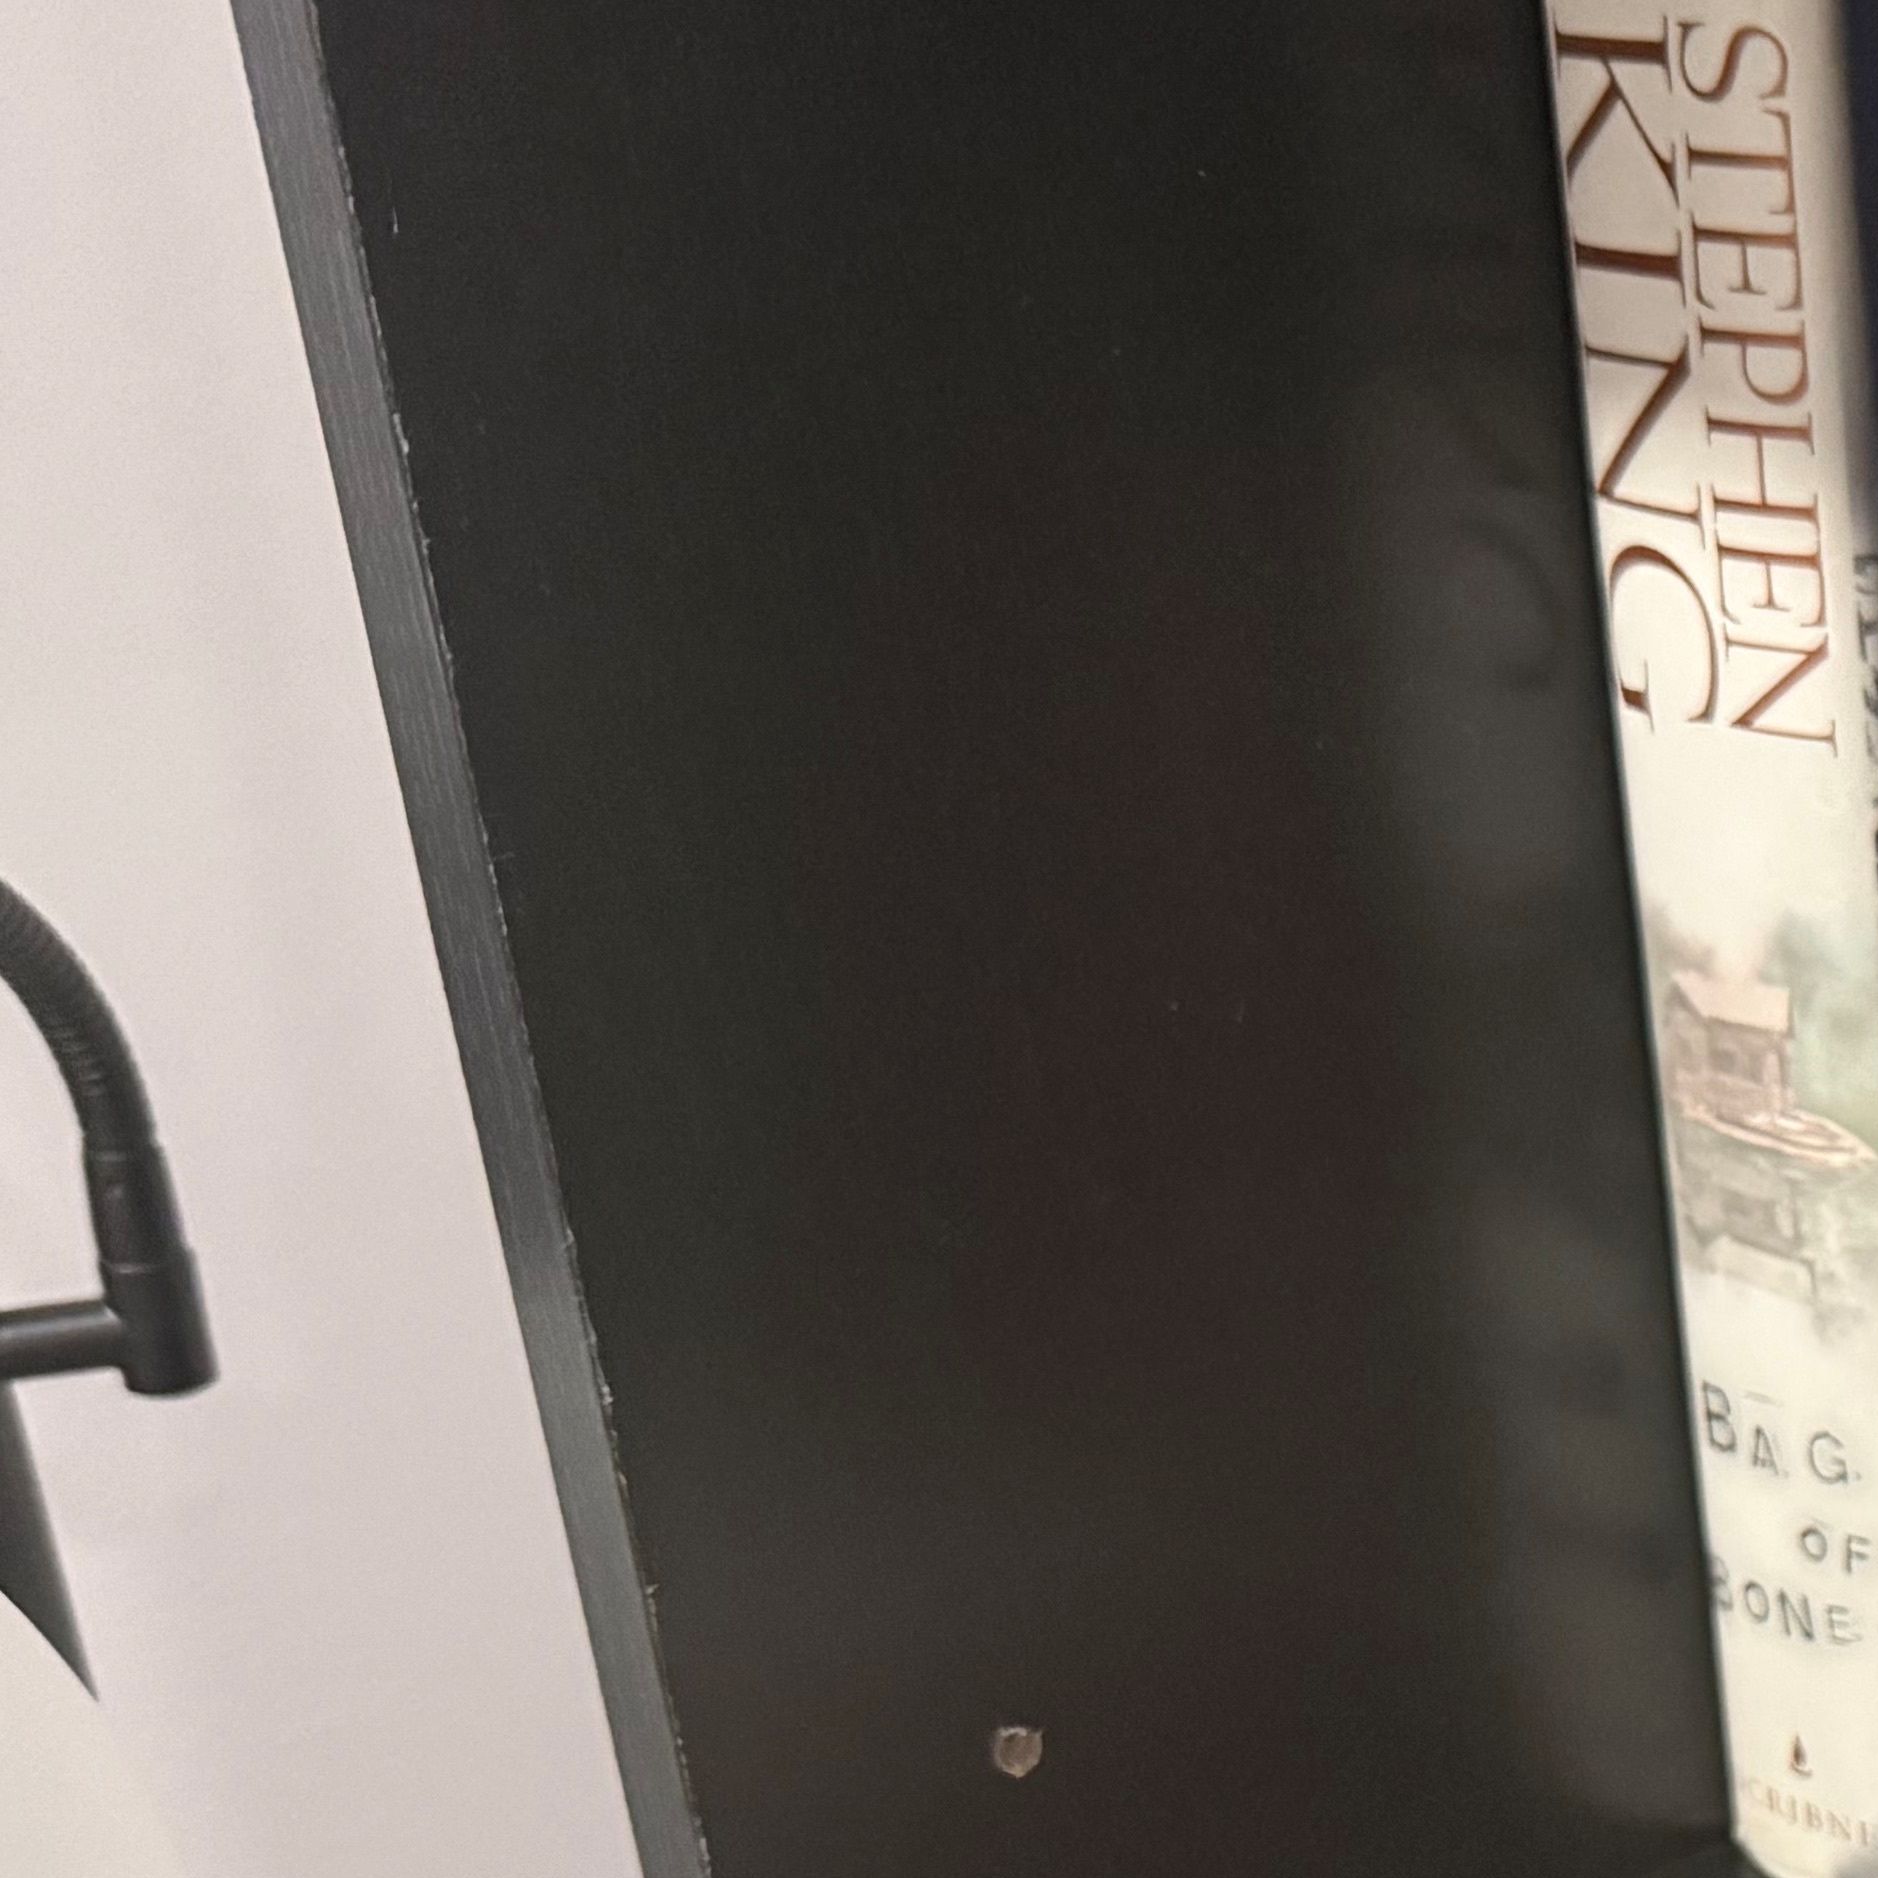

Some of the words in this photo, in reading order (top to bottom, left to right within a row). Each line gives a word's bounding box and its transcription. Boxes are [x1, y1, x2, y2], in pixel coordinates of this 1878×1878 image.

[1553, 8, 1720, 735] KING
[1675, 18, 1838, 758] STEPHEN
[1799, 1521, 1871, 1575] OF
